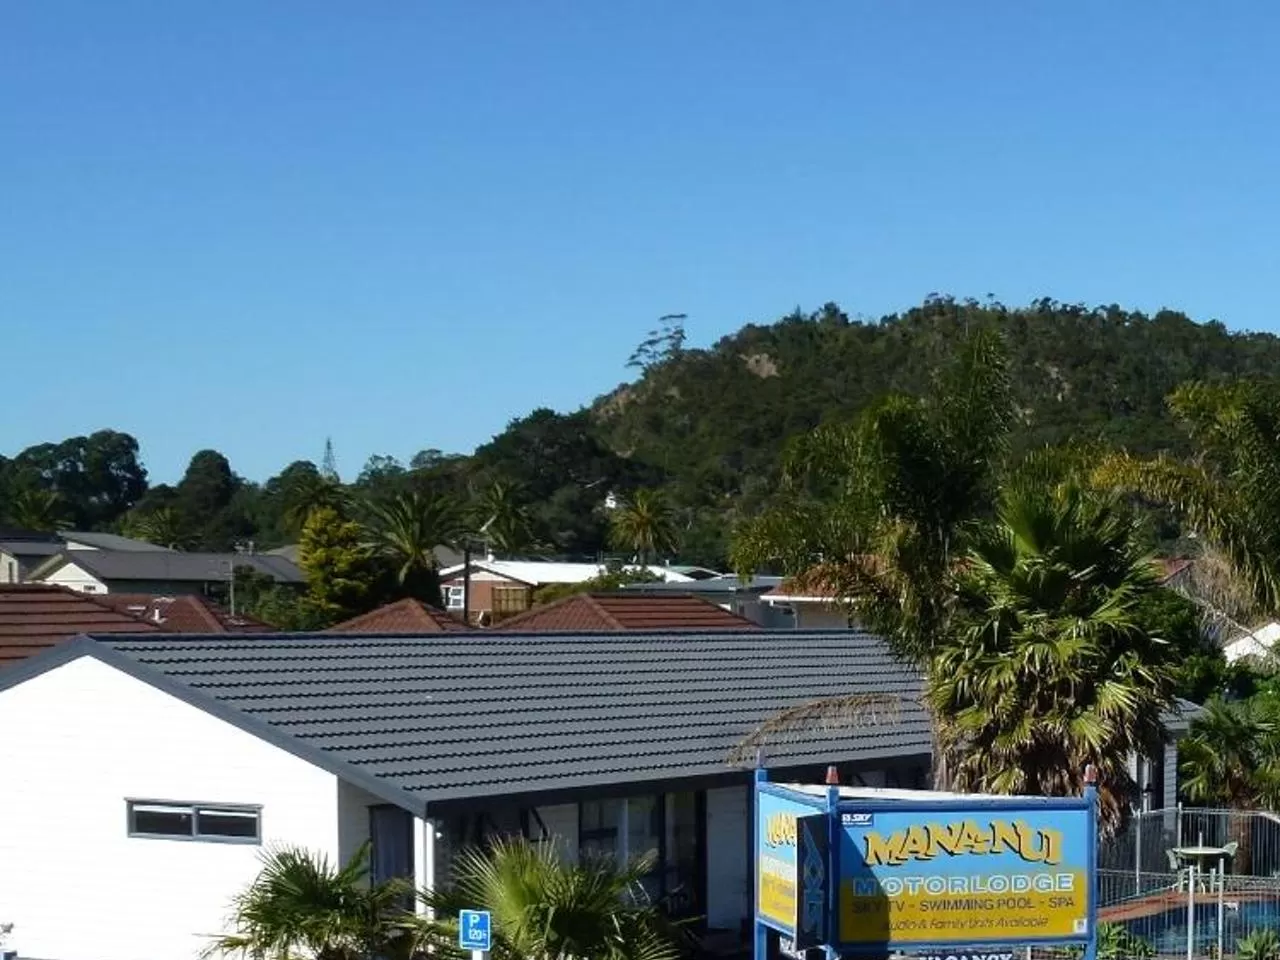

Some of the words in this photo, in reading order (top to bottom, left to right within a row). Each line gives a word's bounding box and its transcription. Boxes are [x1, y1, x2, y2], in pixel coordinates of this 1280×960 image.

[853, 873, 1075, 896] MOTORLODGE
[888, 900, 905, 913] TV
[919, 898, 994, 912] SWIMMING
[998, 897, 1035, 909] POOL
[1048, 896, 1075, 908] SPA
[470, 914, 480, 928] P
